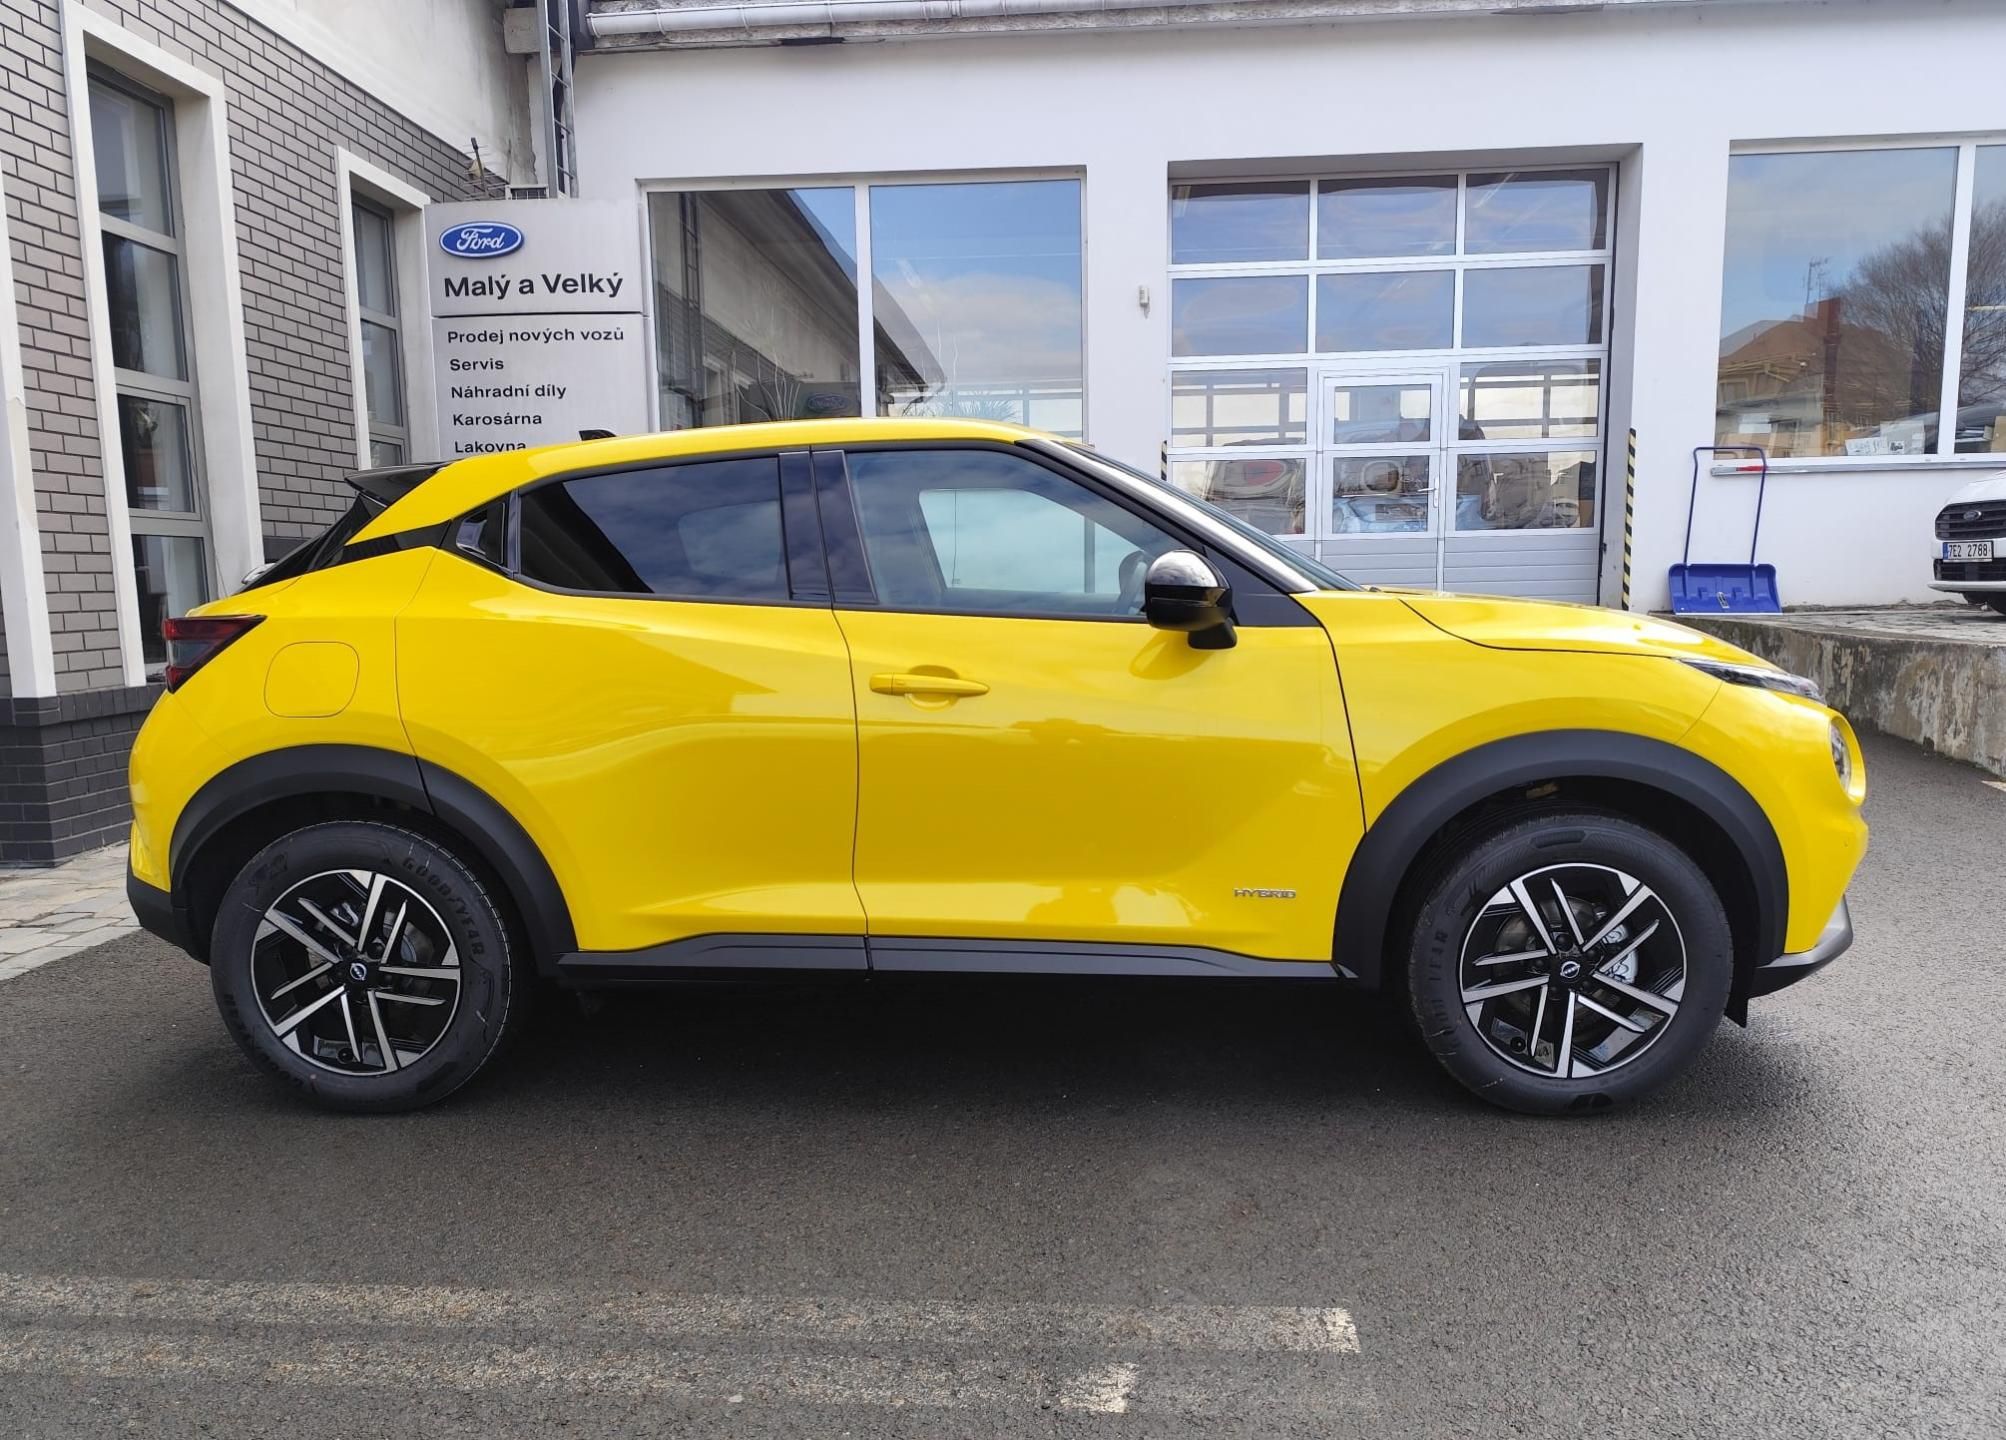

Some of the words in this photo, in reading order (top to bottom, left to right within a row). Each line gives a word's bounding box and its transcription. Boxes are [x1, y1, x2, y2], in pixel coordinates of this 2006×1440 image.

[456, 228, 505, 250] Ford
[444, 274, 511, 300] Malý
[518, 277, 535, 294] a
[542, 272, 623, 298] Velký
[448, 330, 504, 345] Prodej
[509, 328, 575, 344] nových
[580, 327, 624, 341] vozů
[449, 357, 505, 372] Servis
[451, 384, 530, 399] Náhradní
[535, 384, 567, 399] díly
[452, 412, 543, 426] Karosárna
[454, 440, 526, 453] Lakovna
[1949, 544, 1962, 557] 7E2
[1967, 543, 1988, 557] 2788
[1233, 887, 1297, 899] HYBRID
